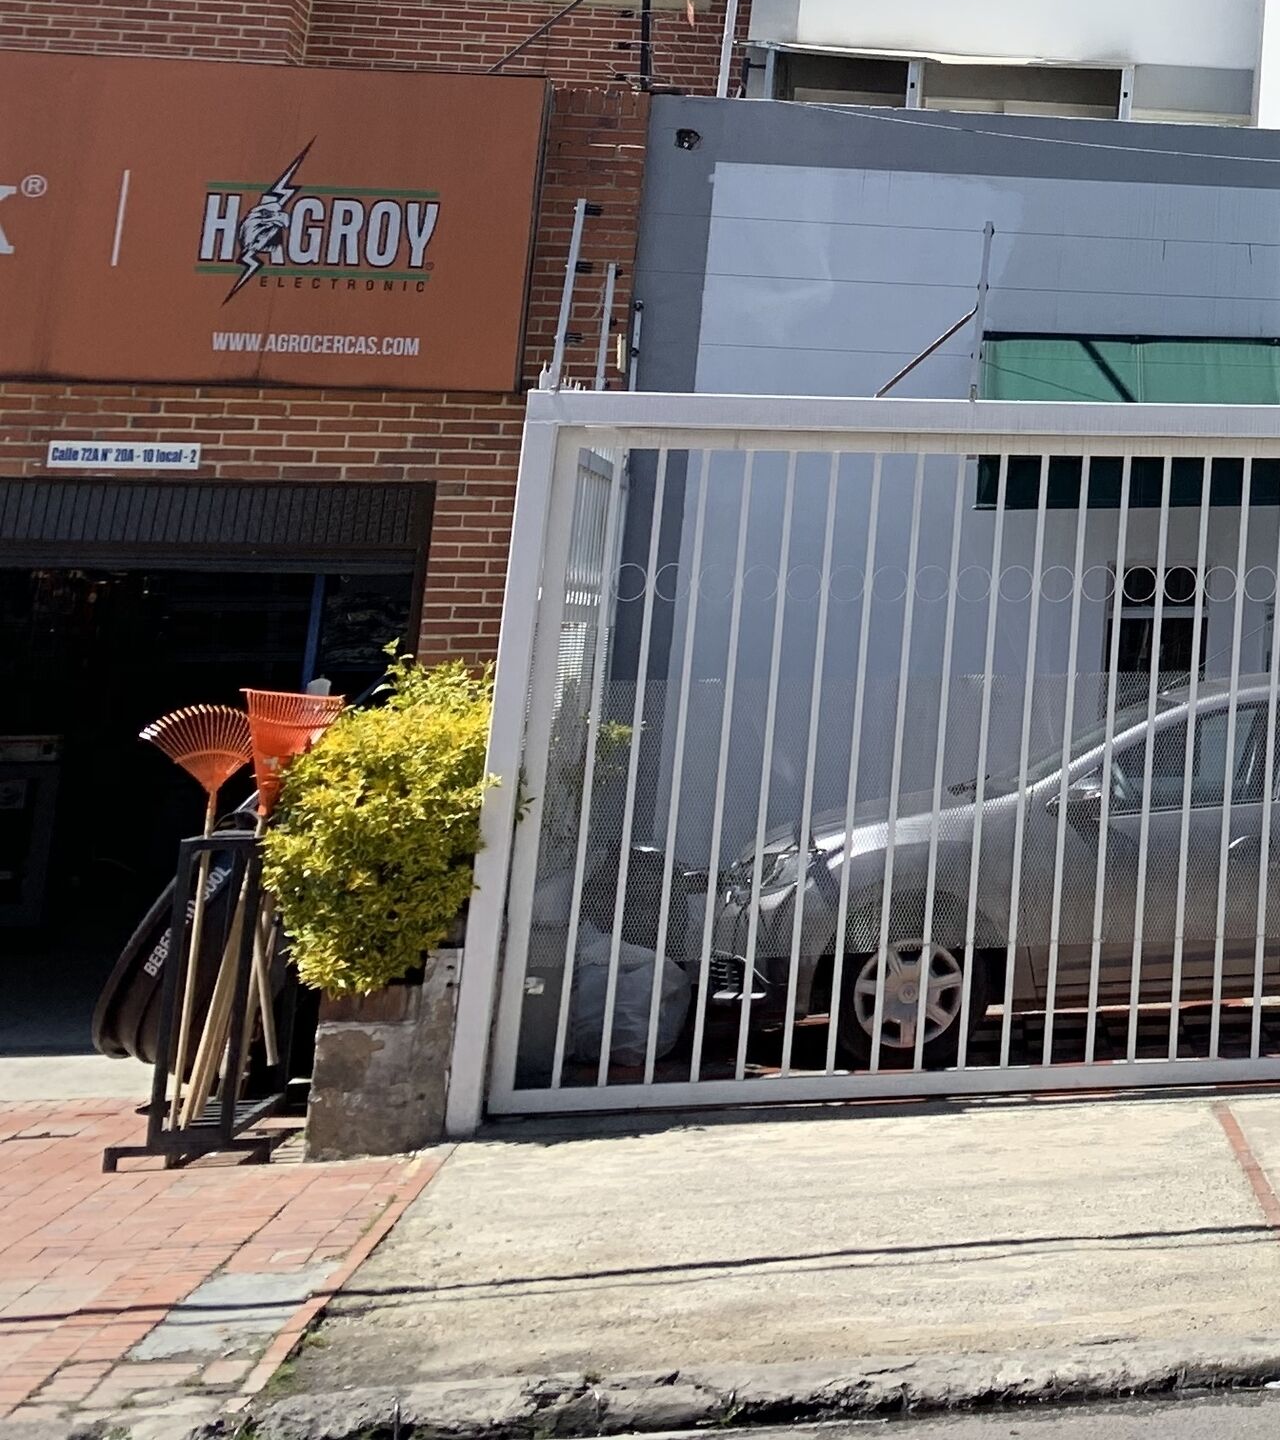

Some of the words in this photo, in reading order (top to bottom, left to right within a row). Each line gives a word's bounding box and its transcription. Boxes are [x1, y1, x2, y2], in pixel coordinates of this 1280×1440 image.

[258, 275, 425, 293] ELECTRONIC
[212, 331, 420, 356] WWW.AGROCERCAS.COM
[51, 447, 79, 461] Calle
[81, 448, 99, 461] 72A
[115, 449, 134, 462] 20A
[156, 449, 182, 463] local
[190, 449, 196, 463] 2
